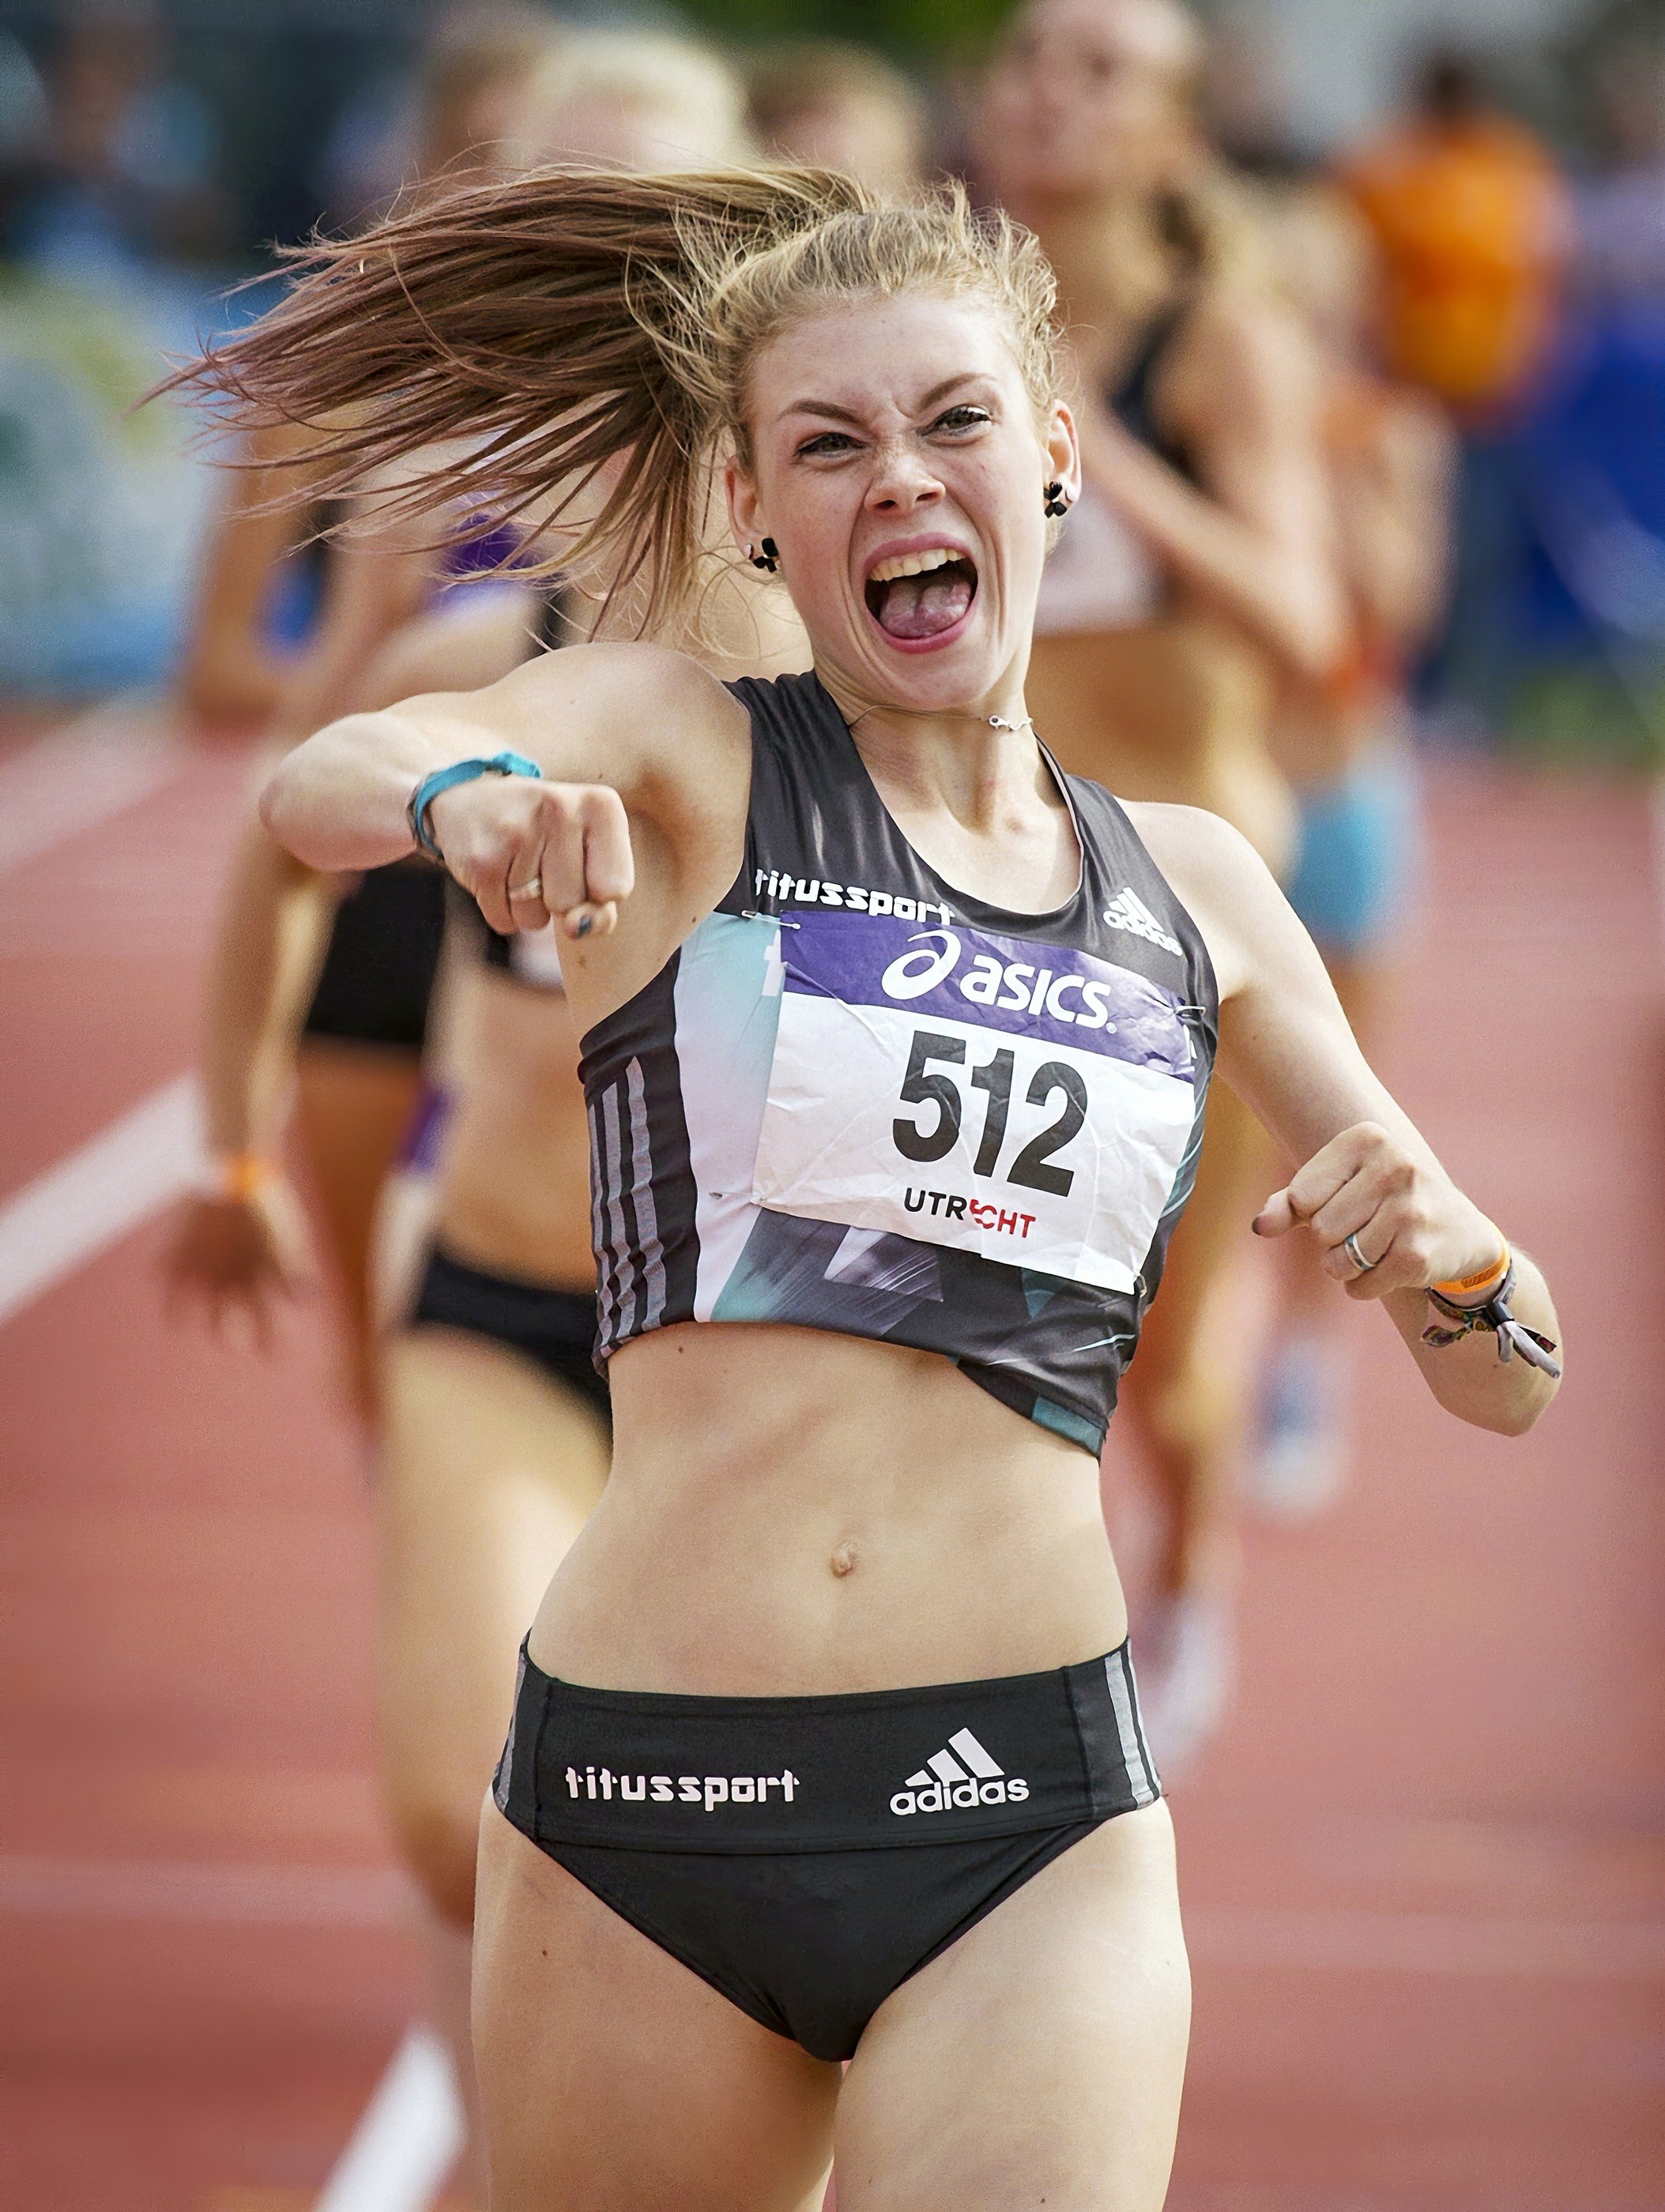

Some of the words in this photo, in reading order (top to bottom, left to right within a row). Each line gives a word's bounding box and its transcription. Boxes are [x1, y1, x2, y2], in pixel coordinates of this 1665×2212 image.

[755, 868, 955, 926] titussport
[892, 1029, 1088, 1198] 512
[565, 1766, 800, 1812] titussport
[889, 1778, 1030, 1816] adidas
